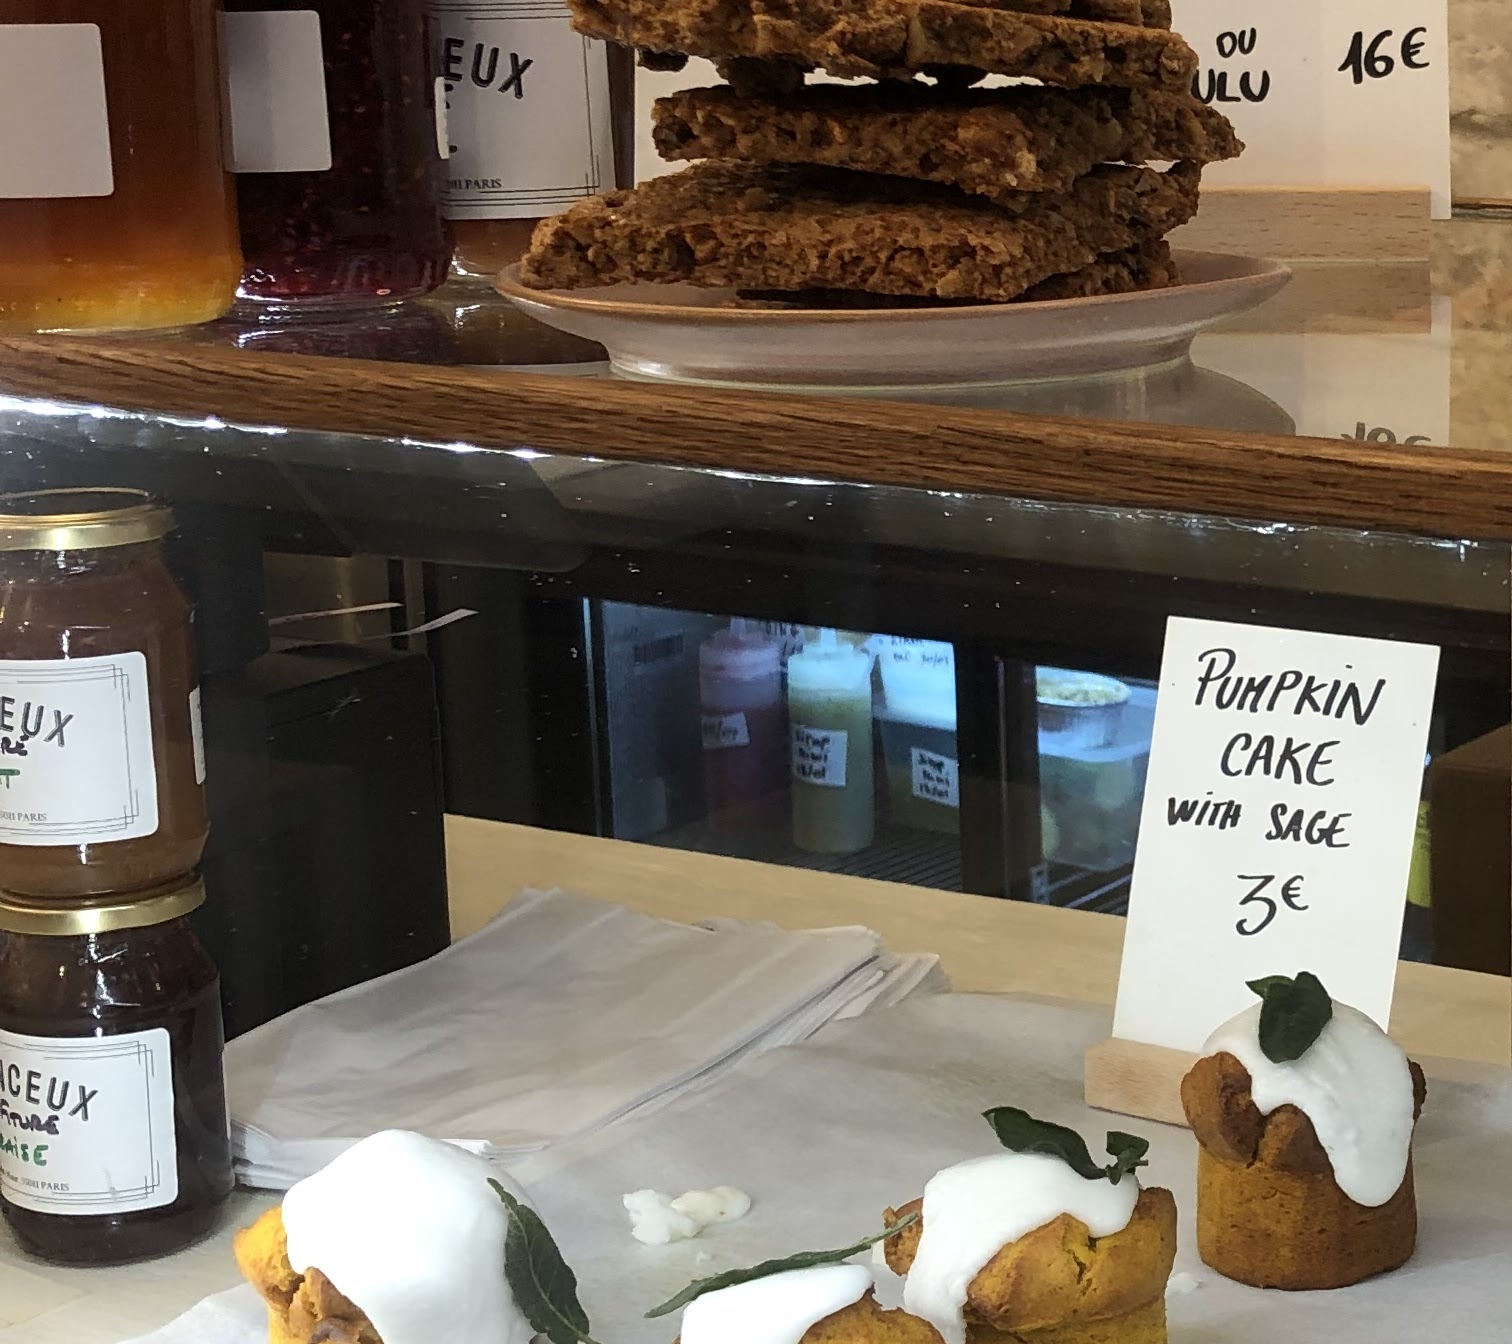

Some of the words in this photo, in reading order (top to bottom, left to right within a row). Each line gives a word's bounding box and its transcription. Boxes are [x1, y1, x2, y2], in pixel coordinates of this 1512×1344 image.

[1216, 27, 1257, 58] OU
[1190, 69, 1270, 105] ULU
[1338, 27, 1430, 84] 16€
[466, 178, 502, 190] PARIS
[1220, 731, 1340, 786] CAKE
[17, 812, 47, 822] PARIS
[1265, 803, 1352, 848] SAGE
[1234, 873, 1309, 936] 3€
